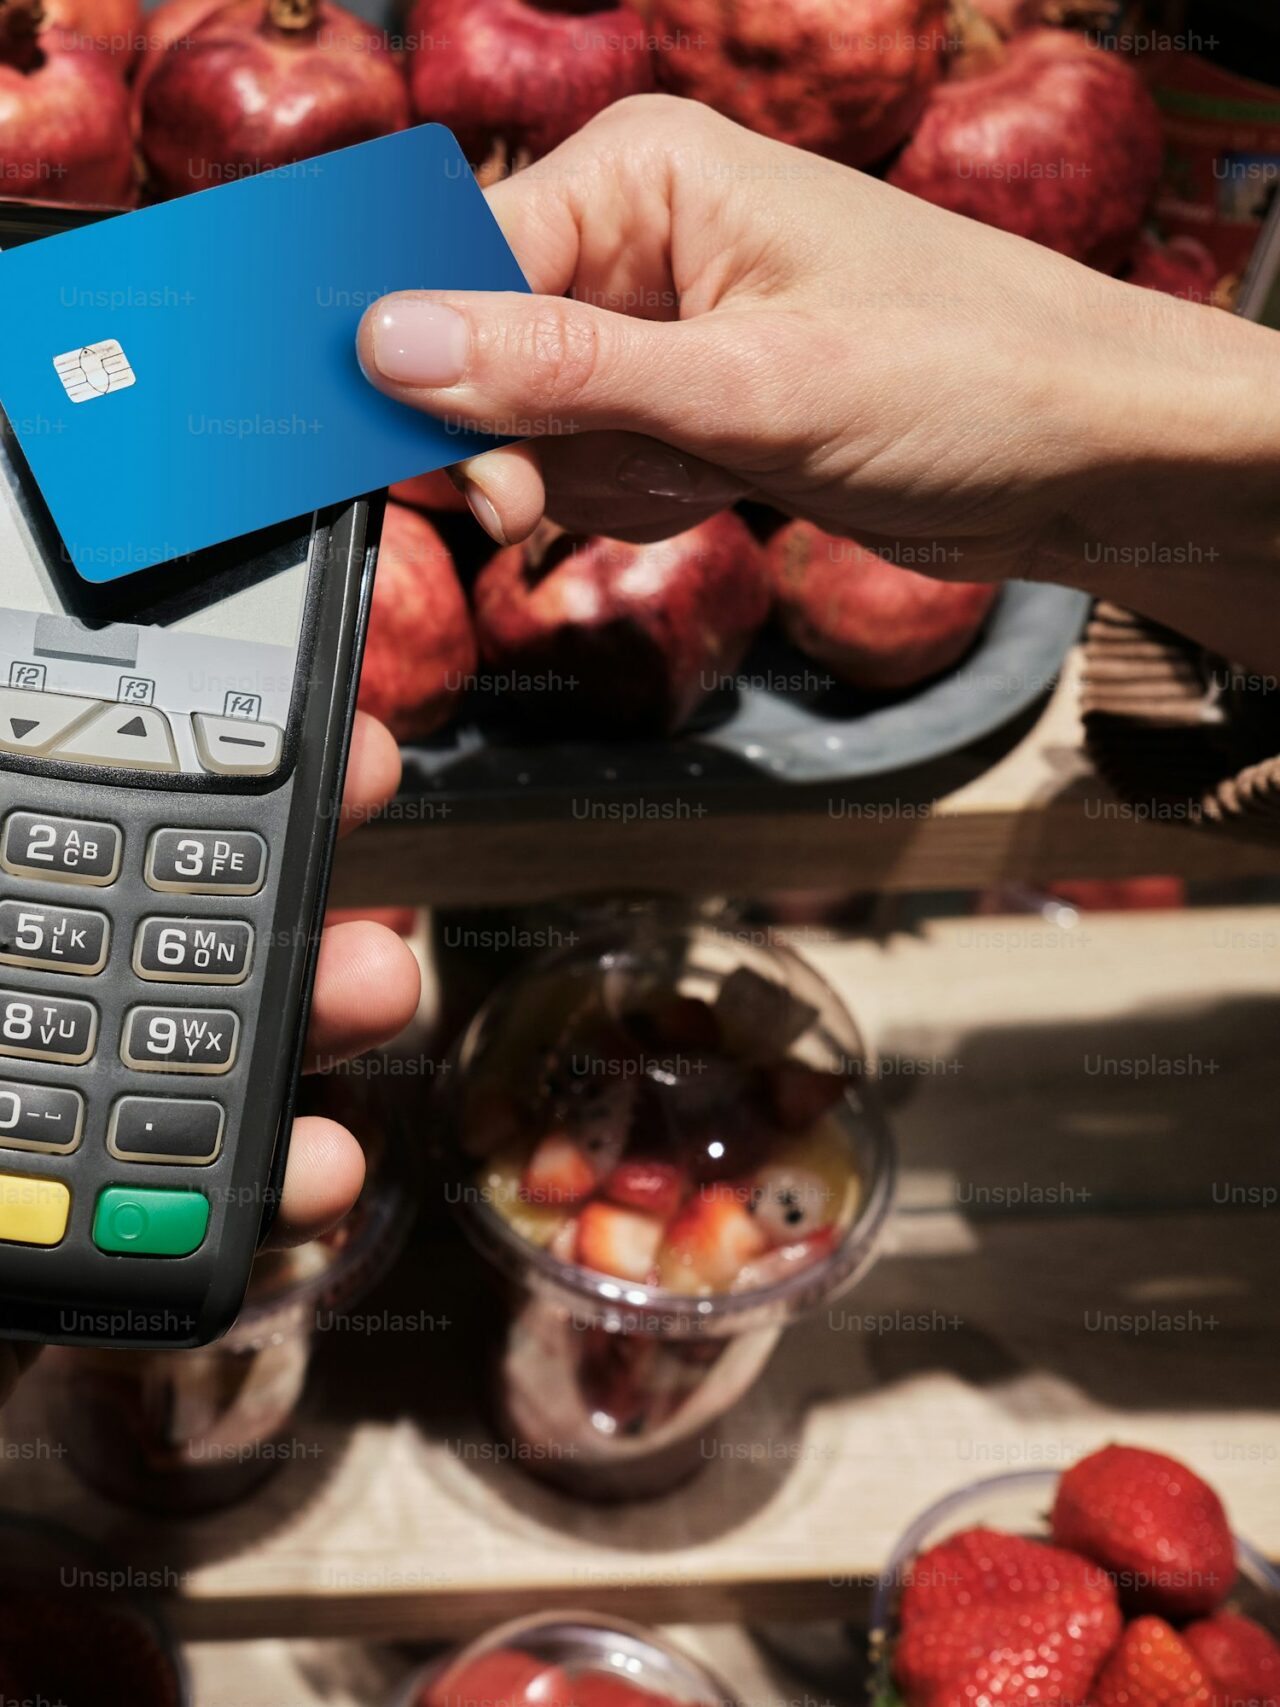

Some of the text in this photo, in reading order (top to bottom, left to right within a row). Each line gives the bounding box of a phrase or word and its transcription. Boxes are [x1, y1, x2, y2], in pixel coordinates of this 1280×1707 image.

[16, 666, 40, 685] f2
[124, 681, 149, 700] f3
[230, 696, 254, 715] f4
[26, 824, 57, 861] 2
[175, 840, 205, 876] 3
[15, 913, 45, 950] 5
[157, 929, 187, 965] 6
[2, 1002, 33, 1040] 8
[146, 1017, 177, 1054] 9
